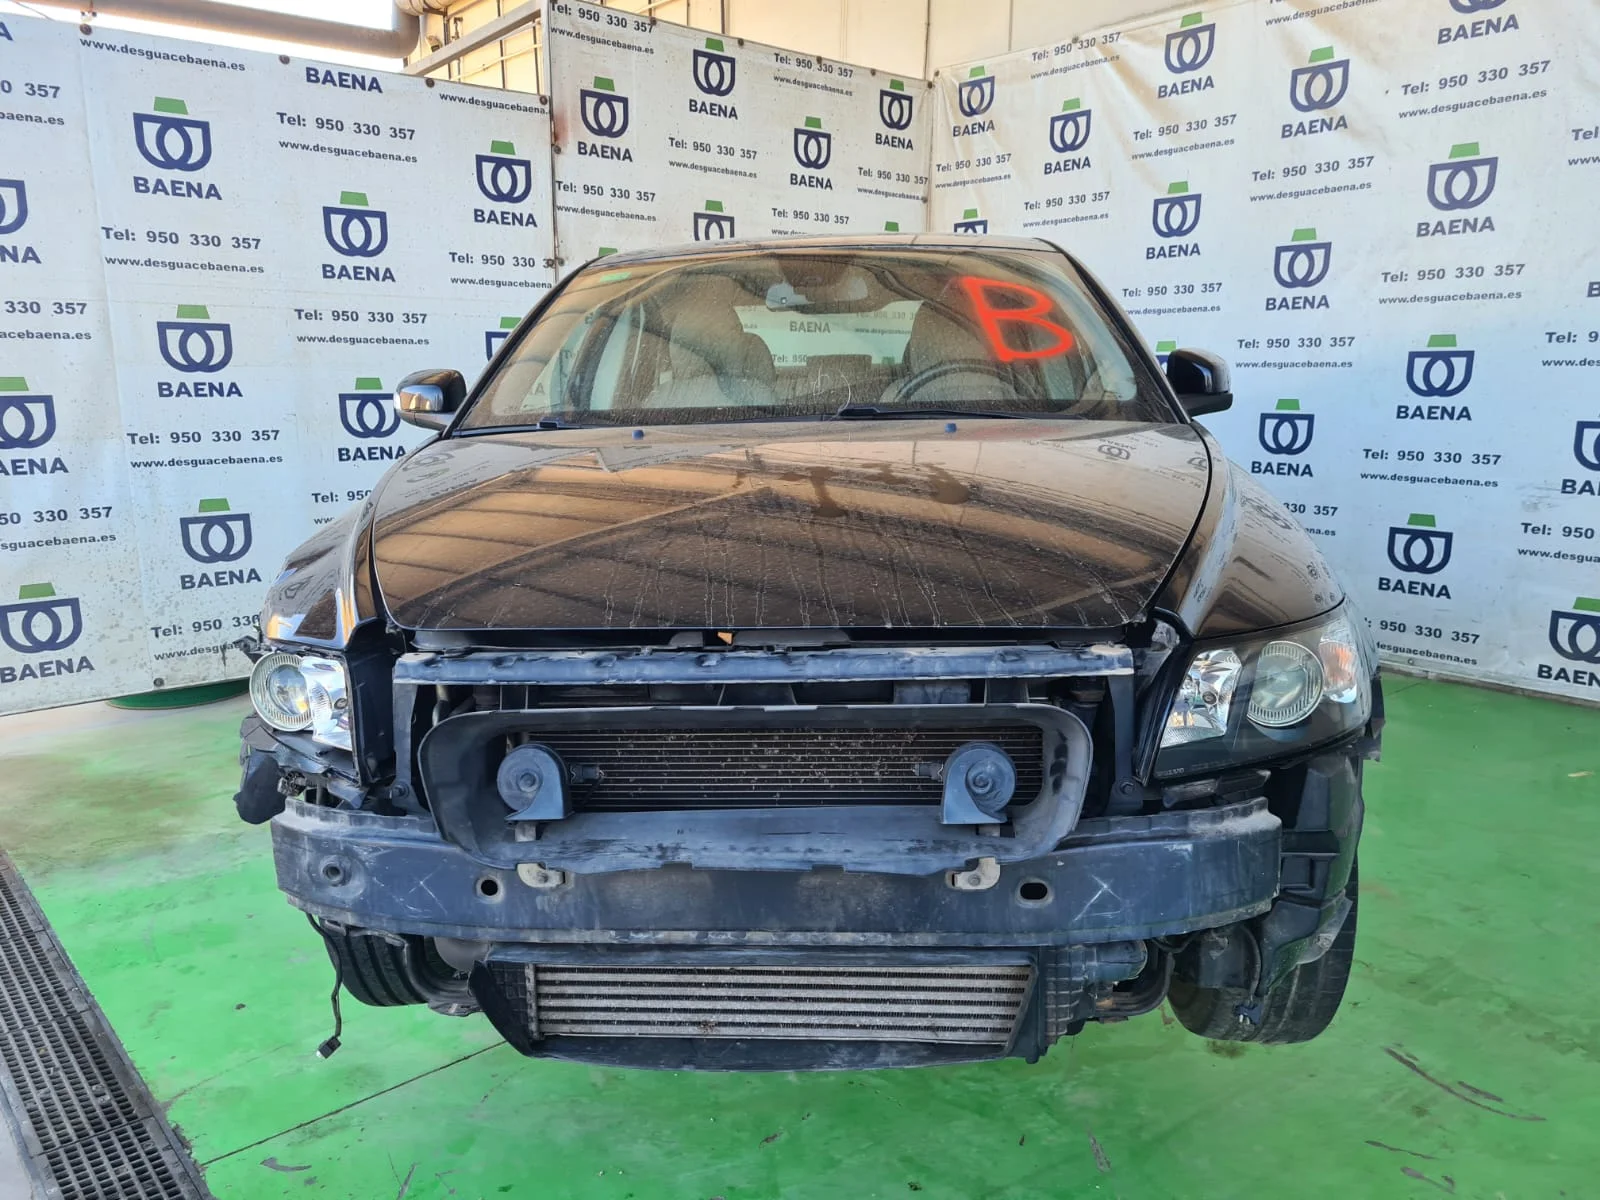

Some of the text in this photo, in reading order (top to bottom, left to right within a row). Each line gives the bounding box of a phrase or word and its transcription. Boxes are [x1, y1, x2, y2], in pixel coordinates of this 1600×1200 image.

[578, 8, 601, 22] 950
[606, 14, 628, 28] 330
[633, 20, 655, 33] 357
[1438, 14, 1519, 44] BAENA
[550, 26, 655, 54] www.desguacebaena.es
[1032, 32, 1122, 62] Tel: 950 330 357
[80, 39, 245, 71] www.desguacebaena.es
[774, 53, 854, 78] Tel: 950 330 357
[1031, 55, 1119, 79] www.desguacebaena.es
[306, 67, 383, 94] BAENA
[1402, 60, 1551, 95] Tel: 950 330 357
[25, 83, 60, 98] 357
[1158, 75, 1214, 99] BAENA
[689, 98, 738, 120] BAENA
[1399, 90, 1546, 118] www.desguacebaena.es
[276, 112, 415, 140] Tel: 950 330 357
[953, 120, 995, 137] BAENA
[1133, 114, 1237, 140] Tel: 950 330 357
[1281, 115, 1348, 138] BAENA
[668, 137, 757, 160] Tel: 950 330 357
[875, 133, 913, 151] BAENA
[1132, 139, 1234, 159] www.desguacebaena.es
[279, 141, 417, 163] www.desguacebaena.es
[578, 141, 633, 162] BAENA
[669, 160, 757, 178] www.desguacebaena.es
[936, 153, 1011, 172] Tel: 950 330 357
[1044, 156, 1091, 175] BAENA
[1252, 156, 1374, 181] Tel: 950 330 357
[790, 173, 833, 190] BAENA
[858, 167, 928, 185] Tel: 950 330 357
[936, 174, 1011, 188] www.desguacebaena.es
[133, 176, 222, 200] BAENA
[556, 181, 656, 202] Tel: 950 330 357
[1250, 183, 1372, 203] www.desguacebaena.es
[1024, 191, 1110, 211] Tel: 950 330 357
[474, 208, 538, 228] BAENA
[556, 205, 657, 222] www.desguacebaena.es
[772, 208, 849, 224] Tel: 950 330 357
[1023, 213, 1108, 228] www.desguacebaena.es
[1416, 216, 1495, 237] BAENA
[101, 227, 261, 249] Tel: 950 330 357
[449, 252, 473, 264] Tel:
[481, 254, 505, 266] 950
[513, 256, 535, 268] 330
[1146, 243, 1200, 260] BAENA
[105, 257, 265, 274] www.desguacebaena.es
[322, 264, 396, 282] BAENA
[1381, 264, 1525, 282] Tel: 950 330 357
[1122, 282, 1222, 297] Tel: 950 330 357
[1379, 291, 1522, 305] www.desguacebaena.es
[5, 301, 87, 315] 330 357
[1265, 295, 1330, 311] BAENA
[294, 309, 427, 324] Tel: 950 330 357
[961, 276, 1074, 363] B
[789, 321, 831, 333] BAENA
[297, 335, 429, 345] www.desguacebaena.es
[1237, 337, 1355, 349] Tel: 950 330 357
[1545, 332, 1577, 343] Tel:
[1236, 359, 1352, 370] www.desguacebaena.es
[157, 382, 243, 397] BAENA
[1396, 405, 1472, 421] BAENA
[126, 430, 280, 445] Tel: 950 330 357
[130, 456, 283, 468] www.desguacebaena.es
[338, 445, 406, 463] BAENA
[1363, 449, 1501, 465] Tel: 950 330 357
[1251, 461, 1313, 477] BAENA
[1360, 473, 1498, 487] www.desguacebaena.es
[311, 492, 338, 503] Tel:
[33, 509, 68, 523] 330
[79, 506, 112, 519] 357
[1314, 505, 1338, 516] 357
[1521, 522, 1595, 539] Tel: 950
[180, 568, 262, 590] BAENA
[1378, 577, 1451, 599] BAENA
[150, 624, 182, 639] Tel:
[192, 619, 222, 632] 950
[1380, 620, 1406, 633] 950
[1415, 625, 1442, 638] 330
[1451, 631, 1480, 644] 357
[0, 656, 95, 683] BAENA
